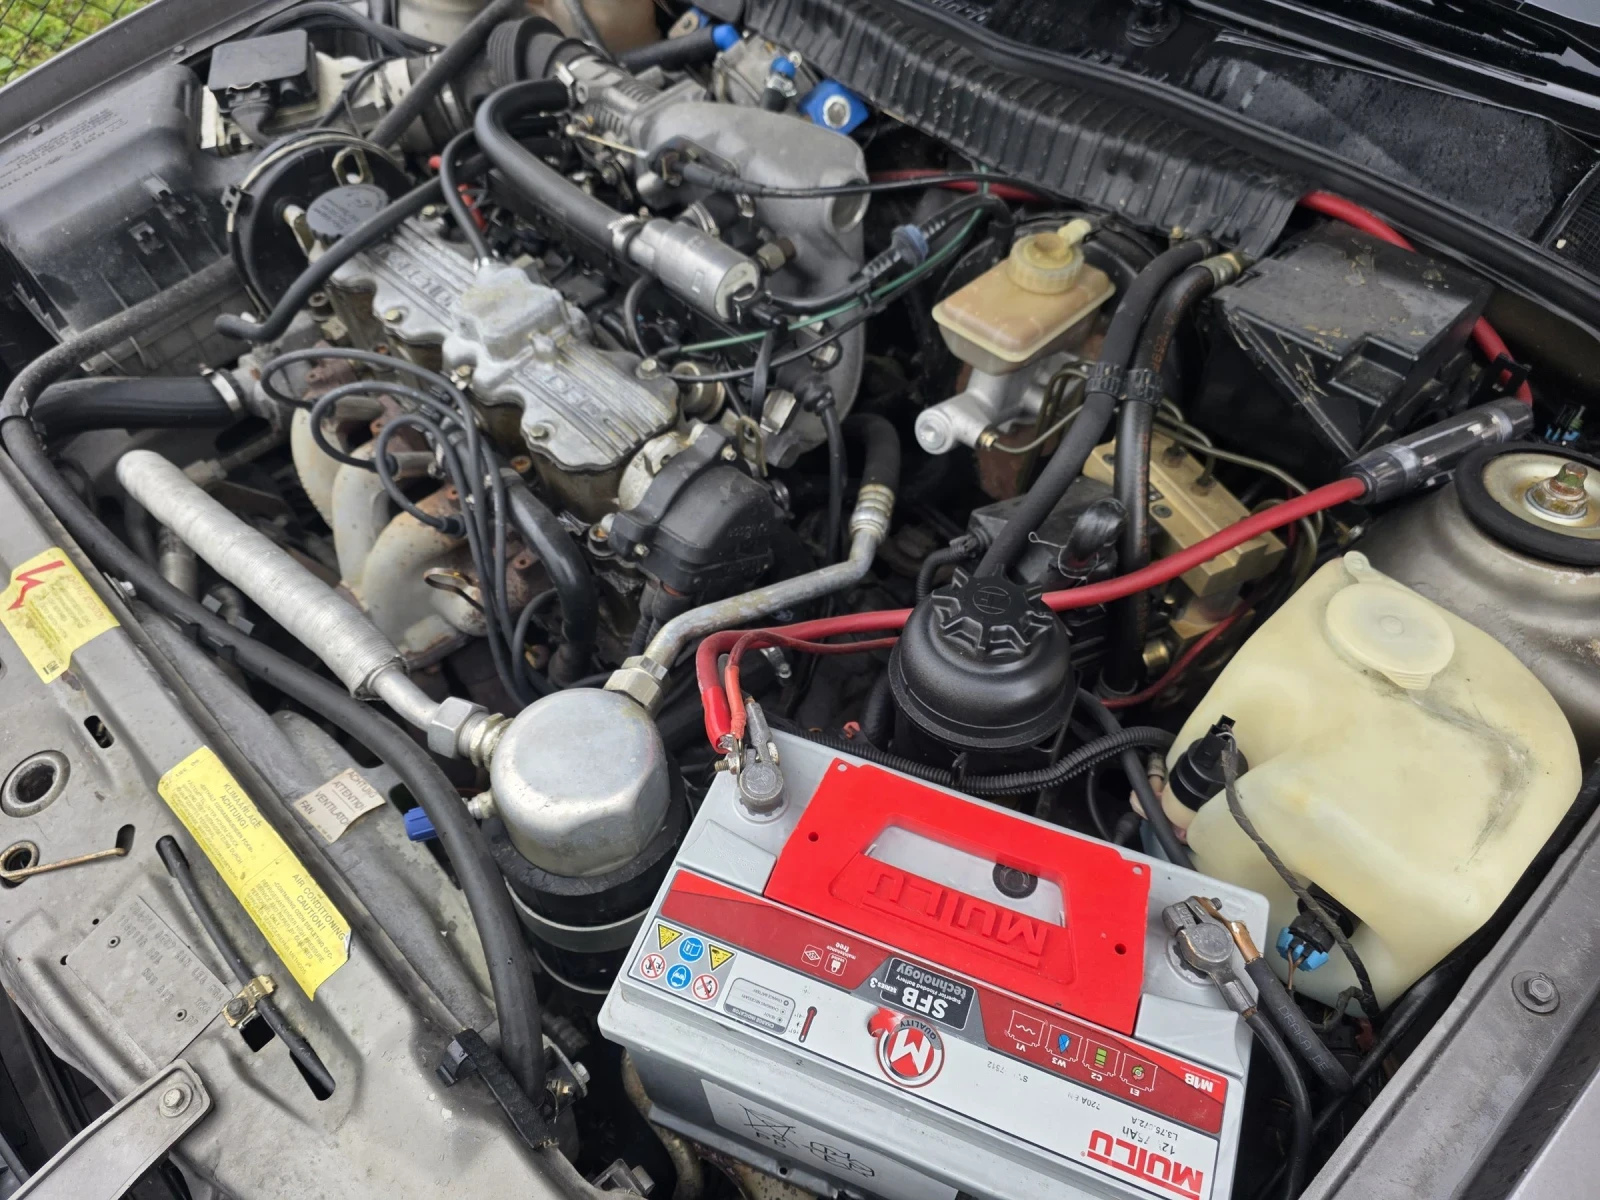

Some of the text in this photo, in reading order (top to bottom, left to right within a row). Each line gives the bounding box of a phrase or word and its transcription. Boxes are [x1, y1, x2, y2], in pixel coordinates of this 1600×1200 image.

[218, 793, 249, 830] ACHTUNG!
[222, 781, 262, 829] KLIMAANLAGE
[299, 800, 316, 816] FAN
[291, 871, 346, 941] AIR CONDITIONING
[295, 893, 326, 932] CAUTION!
[862, 870, 1048, 968] MUTLU
[833, 940, 850, 953] free
[868, 975, 949, 1019] SFB SERIES 3
[894, 961, 967, 998] technology
[898, 1018, 936, 1040] QUALITY
[1277, 1004, 1313, 1051] DRAKA
[1014, 1041, 1027, 1052] V1
[1050, 1055, 1068, 1068] W3
[1089, 1071, 1103, 1082] C2
[1084, 1128, 1203, 1200] MUTLU
